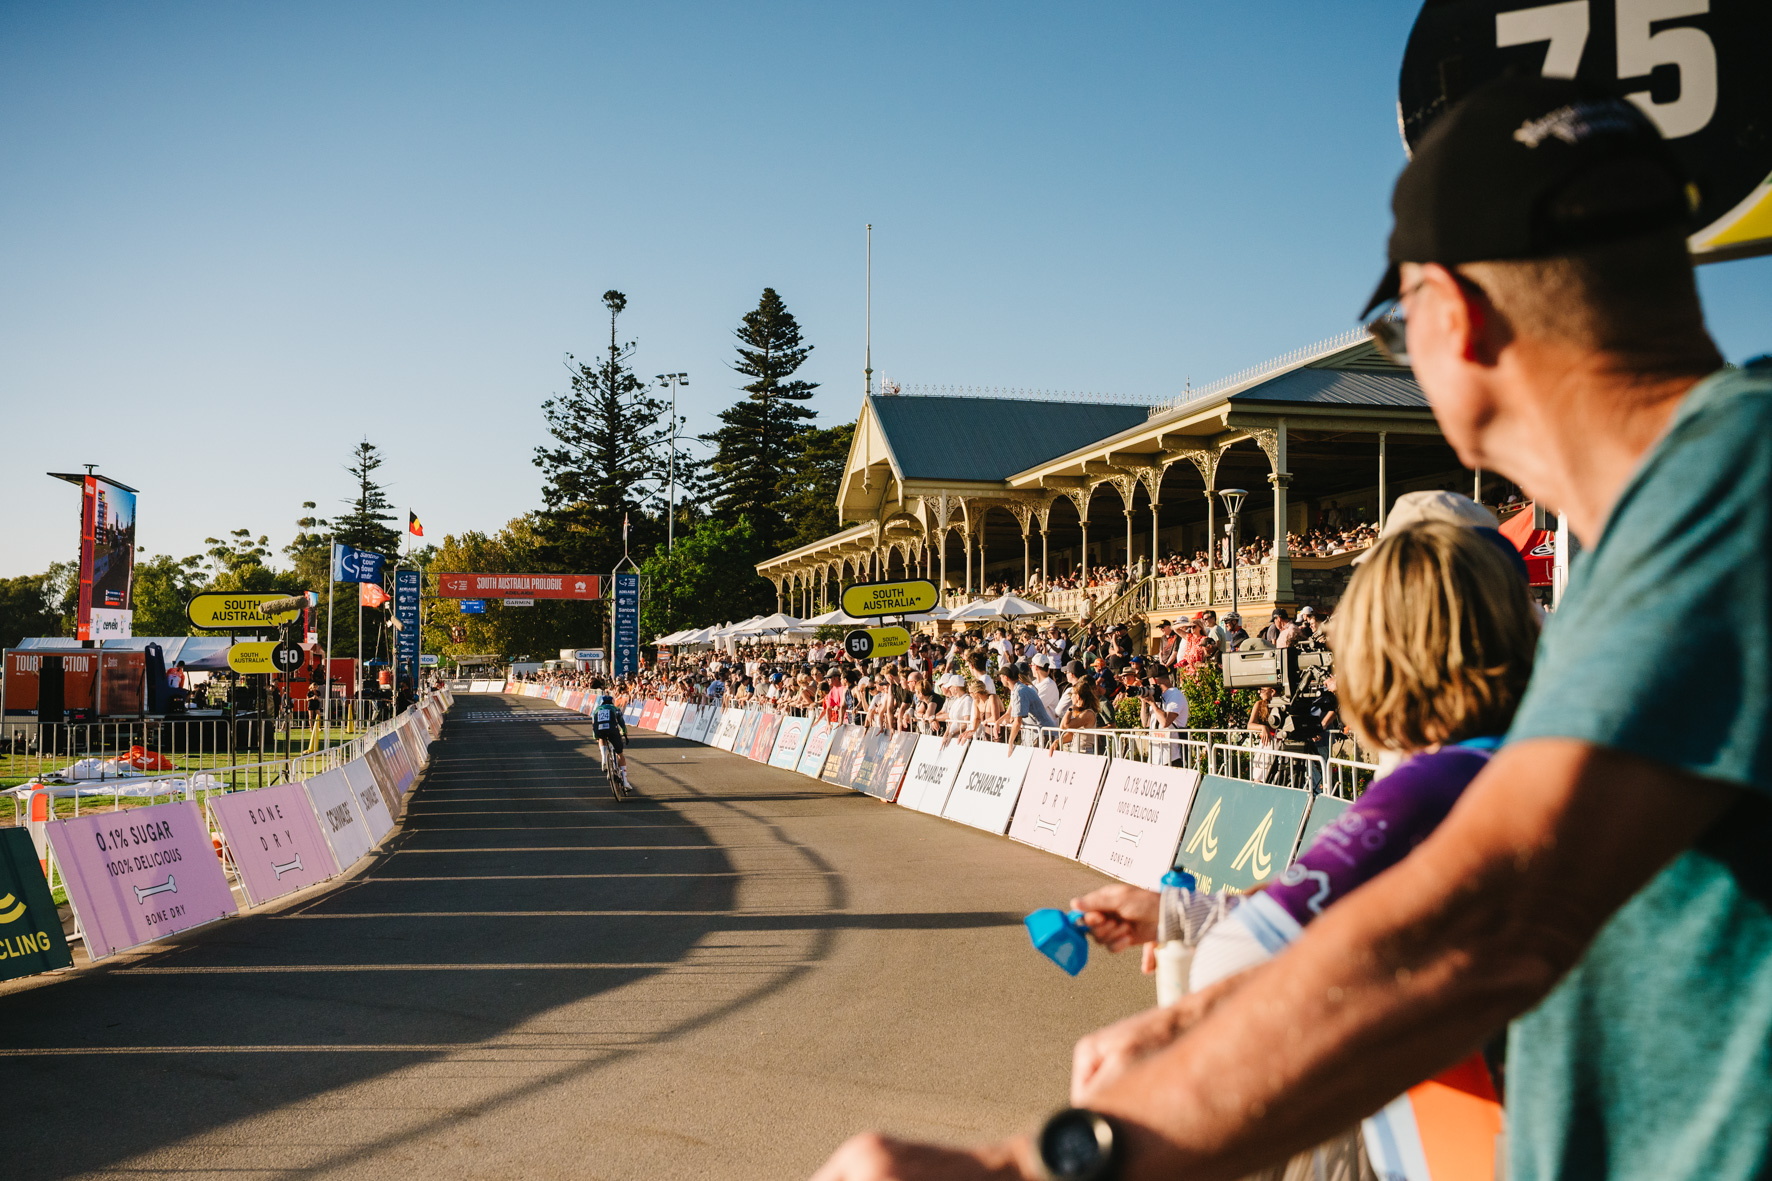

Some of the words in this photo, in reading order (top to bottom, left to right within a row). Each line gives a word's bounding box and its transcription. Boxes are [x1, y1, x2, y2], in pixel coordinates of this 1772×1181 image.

[1495, 0, 1718, 140] 75
[476, 577, 497, 590] SOUTH
[498, 577, 530, 590] AUSTRALIA
[531, 578, 563, 591] PROLOGUE
[872, 588, 905, 599] SOUTH
[224, 600, 261, 610] SOUTH
[863, 597, 916, 611] AUSTRALIA
[211, 611, 274, 621] AUSTRALIA
[851, 637, 869, 652] 50
[15, 655, 39, 672] TOUR
[62, 656, 89, 672] CTION
[279, 649, 299, 664] 50
[915, 762, 948, 785] SCHWALBE
[1049, 767, 1077, 786] BONE
[965, 771, 1010, 797] SCHWALBE
[1123, 775, 1141, 794] 0.1%
[1140, 777, 1168, 801] SUGAR
[1041, 791, 1069, 811] DRY
[248, 804, 283, 825] BONE
[1116, 801, 1131, 816] 100%
[1130, 802, 1160, 824] DELICIOUS
[95, 828, 129, 852] 0.1%
[130, 820, 174, 846] SUGAR
[260, 830, 293, 851] DRY
[106, 858, 134, 878] 100%
[133, 848, 183, 872] DELICIOUS
[1110, 851, 1124, 865] BONE
[1123, 856, 1134, 868] DRY
[145, 910, 169, 926] BONE
[169, 904, 187, 919] DRY
